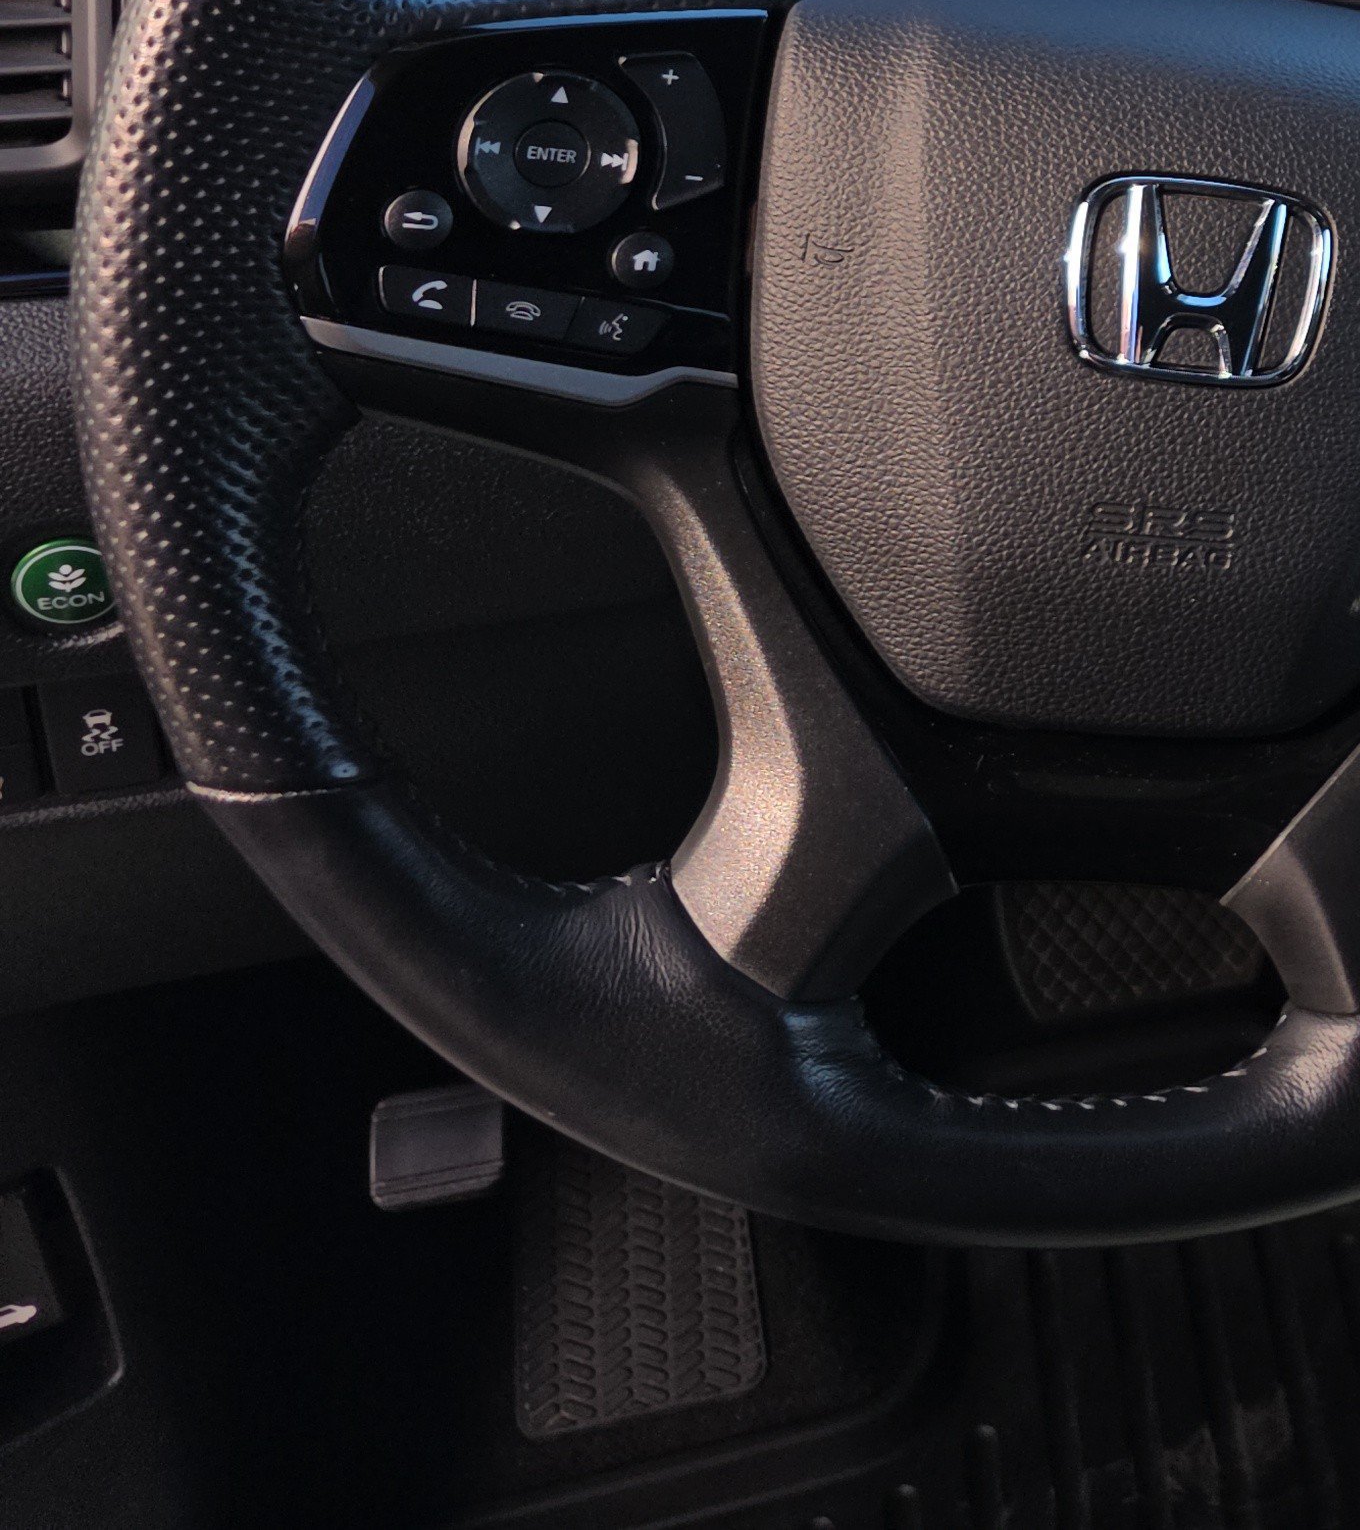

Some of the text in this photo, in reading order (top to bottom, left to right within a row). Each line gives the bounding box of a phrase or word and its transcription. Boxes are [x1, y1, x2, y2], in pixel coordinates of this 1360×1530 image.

[526, 146, 577, 164] ENTER
[1082, 540, 1236, 570] AIRBAG
[37, 591, 105, 611] ECON
[80, 738, 124, 757] OFF
